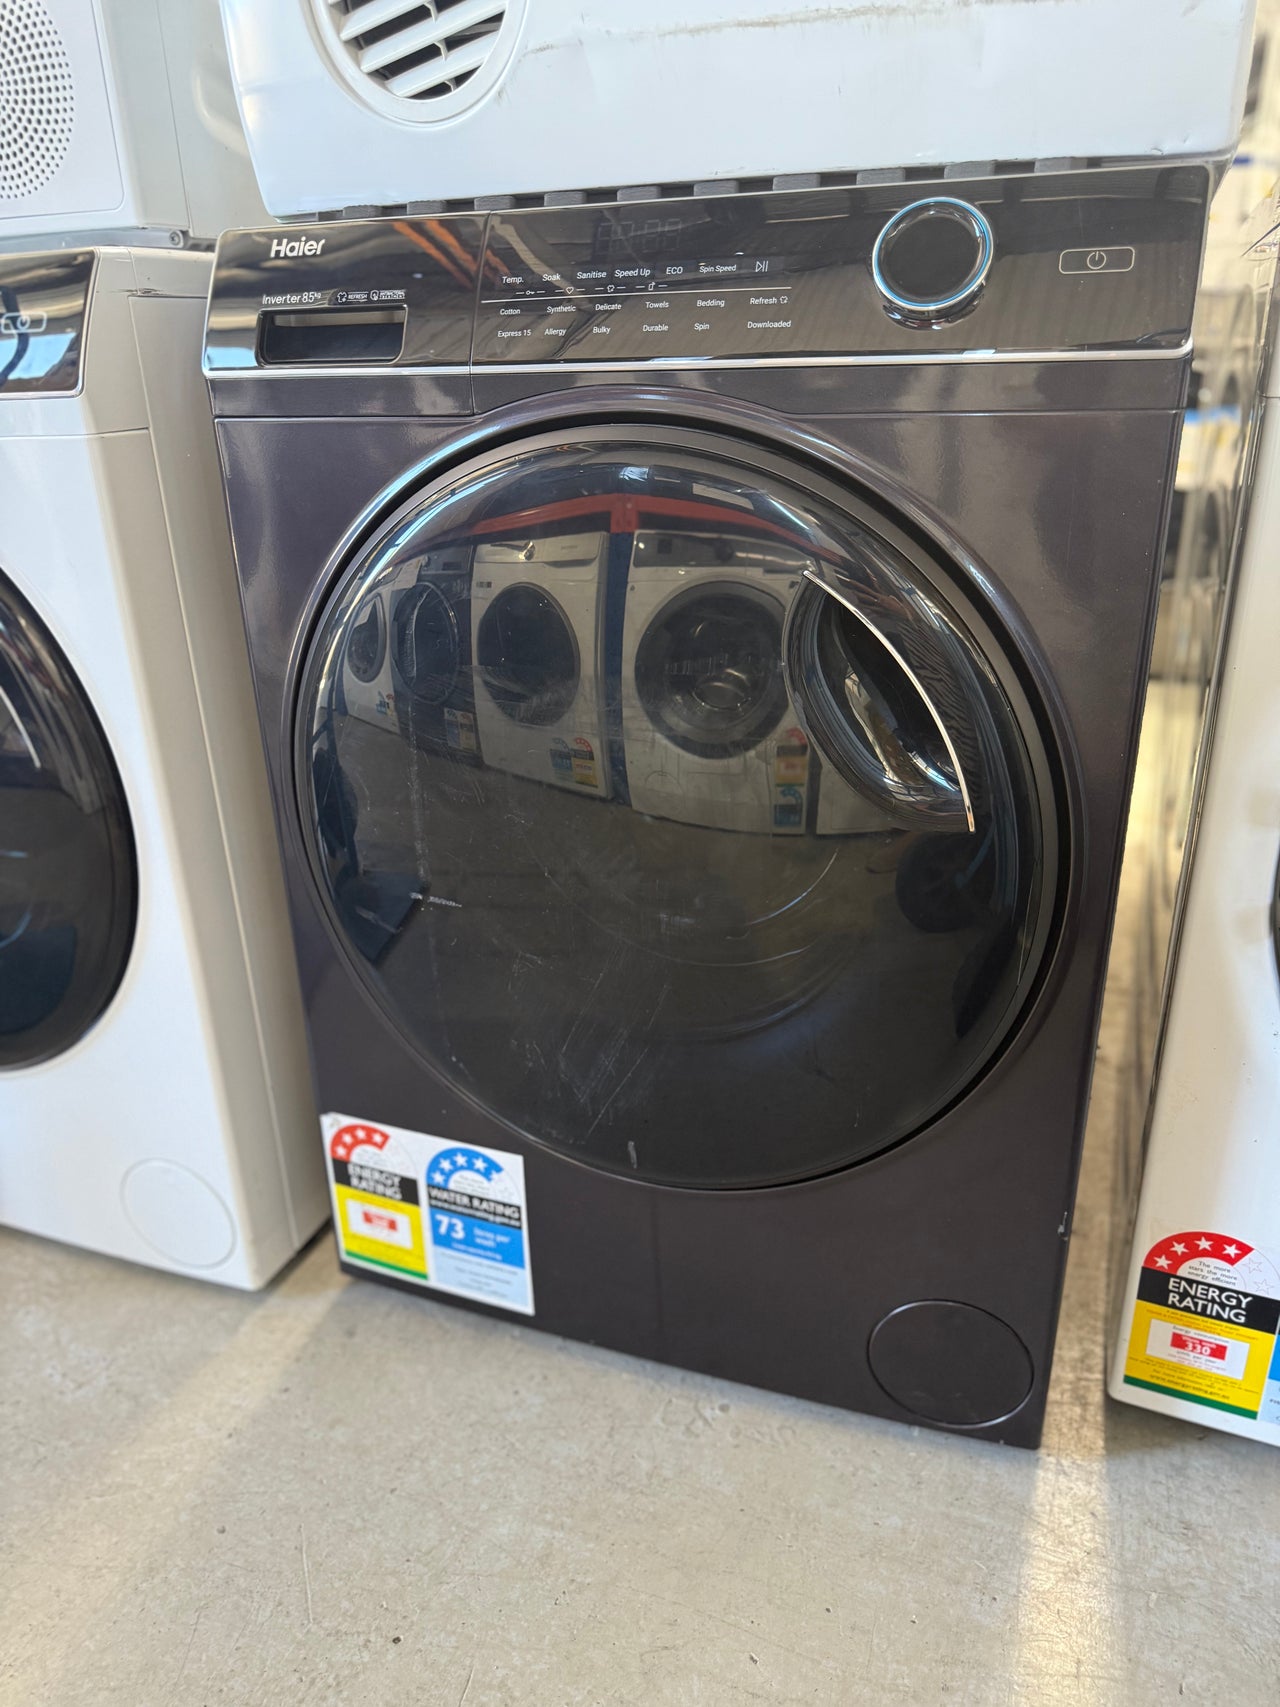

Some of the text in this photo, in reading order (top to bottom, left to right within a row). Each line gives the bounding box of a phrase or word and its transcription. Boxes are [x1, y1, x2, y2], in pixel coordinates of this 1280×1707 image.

[270, 236, 326, 258] Haier
[614, 267, 651, 278] Speed Up
[666, 266, 684, 275] ECO
[699, 264, 737, 274] Spin Speed
[542, 273, 561, 281] Soak
[576, 270, 607, 279] Sanitise
[502, 276, 525, 284] Temp.
[262, 293, 302, 305] Inverter
[696, 299, 725, 308] Bedding
[749, 296, 778, 305] Refresh
[546, 304, 577, 313] Synthetic
[595, 303, 622, 311] Delicate
[645, 301, 670, 309] Towels
[642, 323, 669, 332] Durable
[694, 322, 710, 332] Spin
[747, 319, 792, 329] Downloaded
[497, 329, 532, 339] Express 15
[544, 327, 567, 337] Allergy
[592, 326, 611, 335] Bulky
[348, 1163, 402, 1188] ENERGY
[350, 1178, 403, 1201] RATING
[428, 1187, 471, 1208] WATER
[471, 1197, 521, 1219] RATING
[435, 1214, 466, 1240] 73
[1168, 1277, 1253, 1308] ENERGY
[1167, 1292, 1247, 1324] RATING
